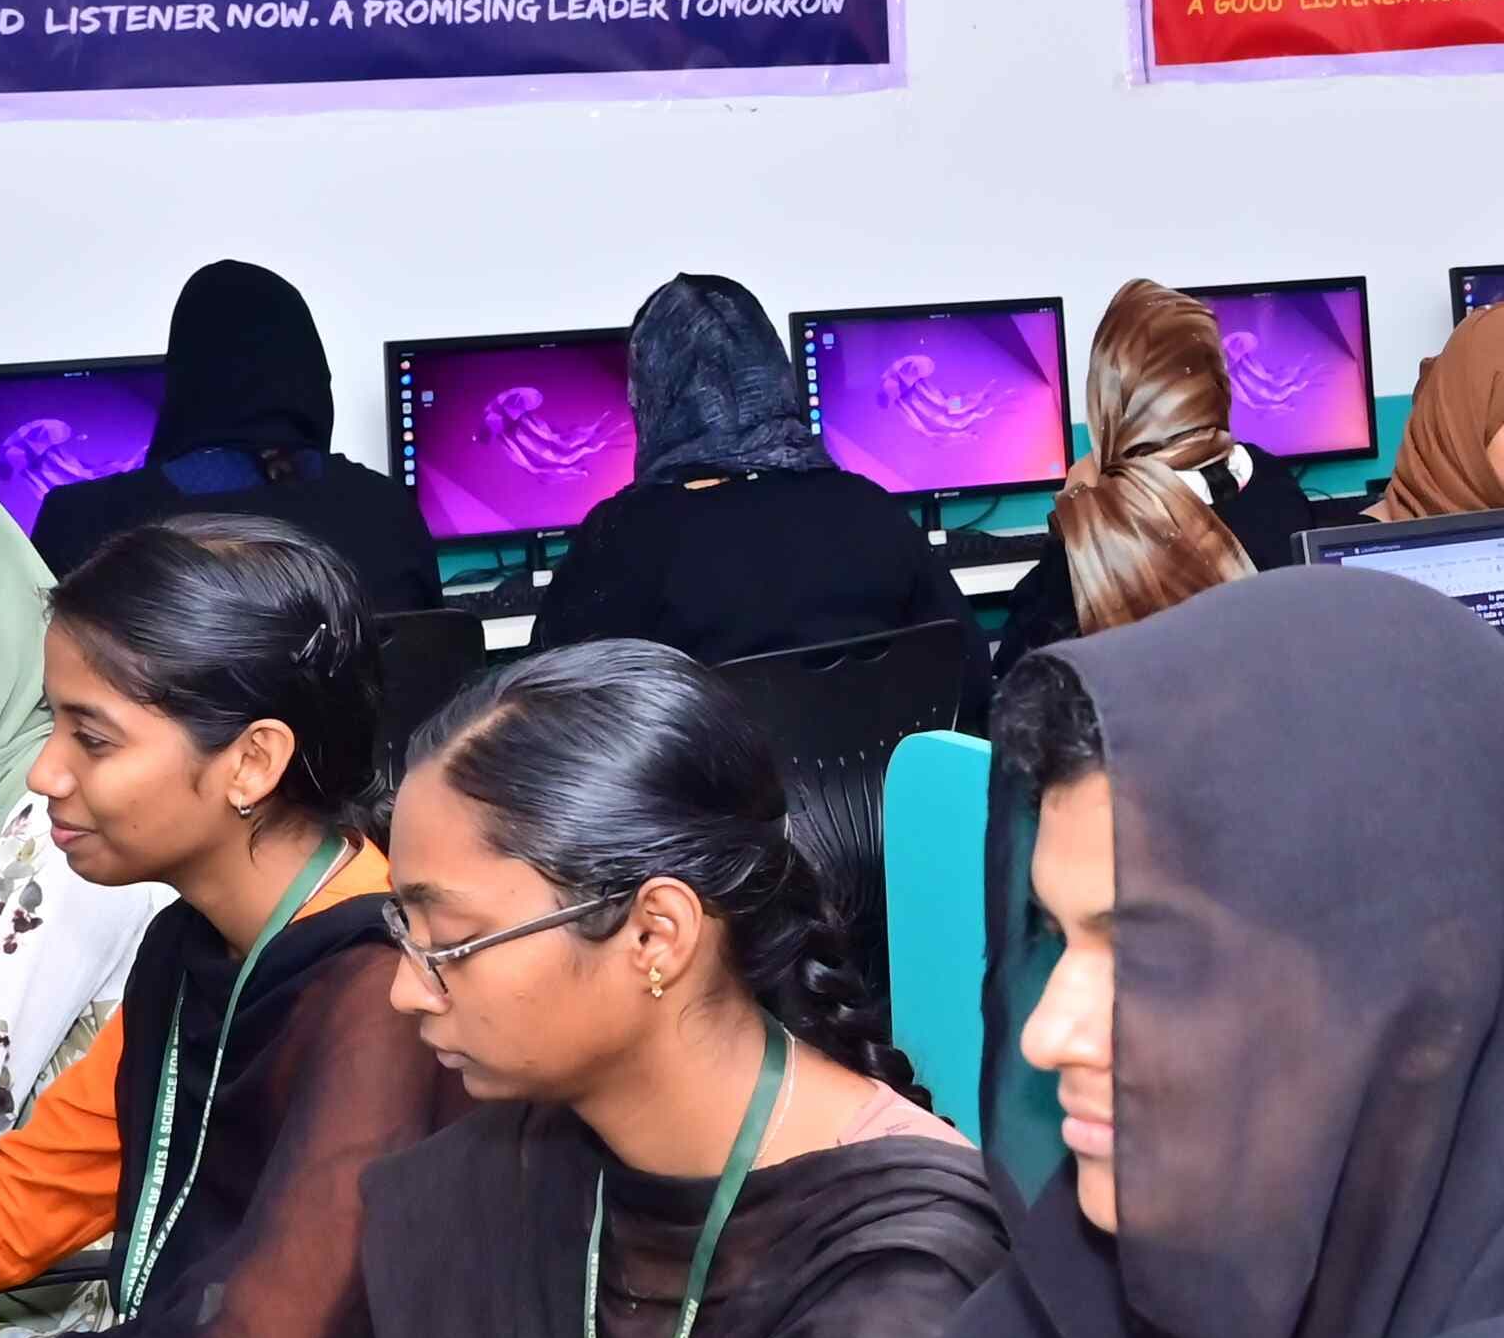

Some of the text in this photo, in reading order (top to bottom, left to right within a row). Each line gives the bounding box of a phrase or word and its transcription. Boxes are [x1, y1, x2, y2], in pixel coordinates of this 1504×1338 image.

[44, 2, 219, 36] LISTENER
[160, 1077, 178, 1134] SCIENCE
[152, 1150, 168, 1185] ARTS
[148, 1187, 161, 1205] OF
